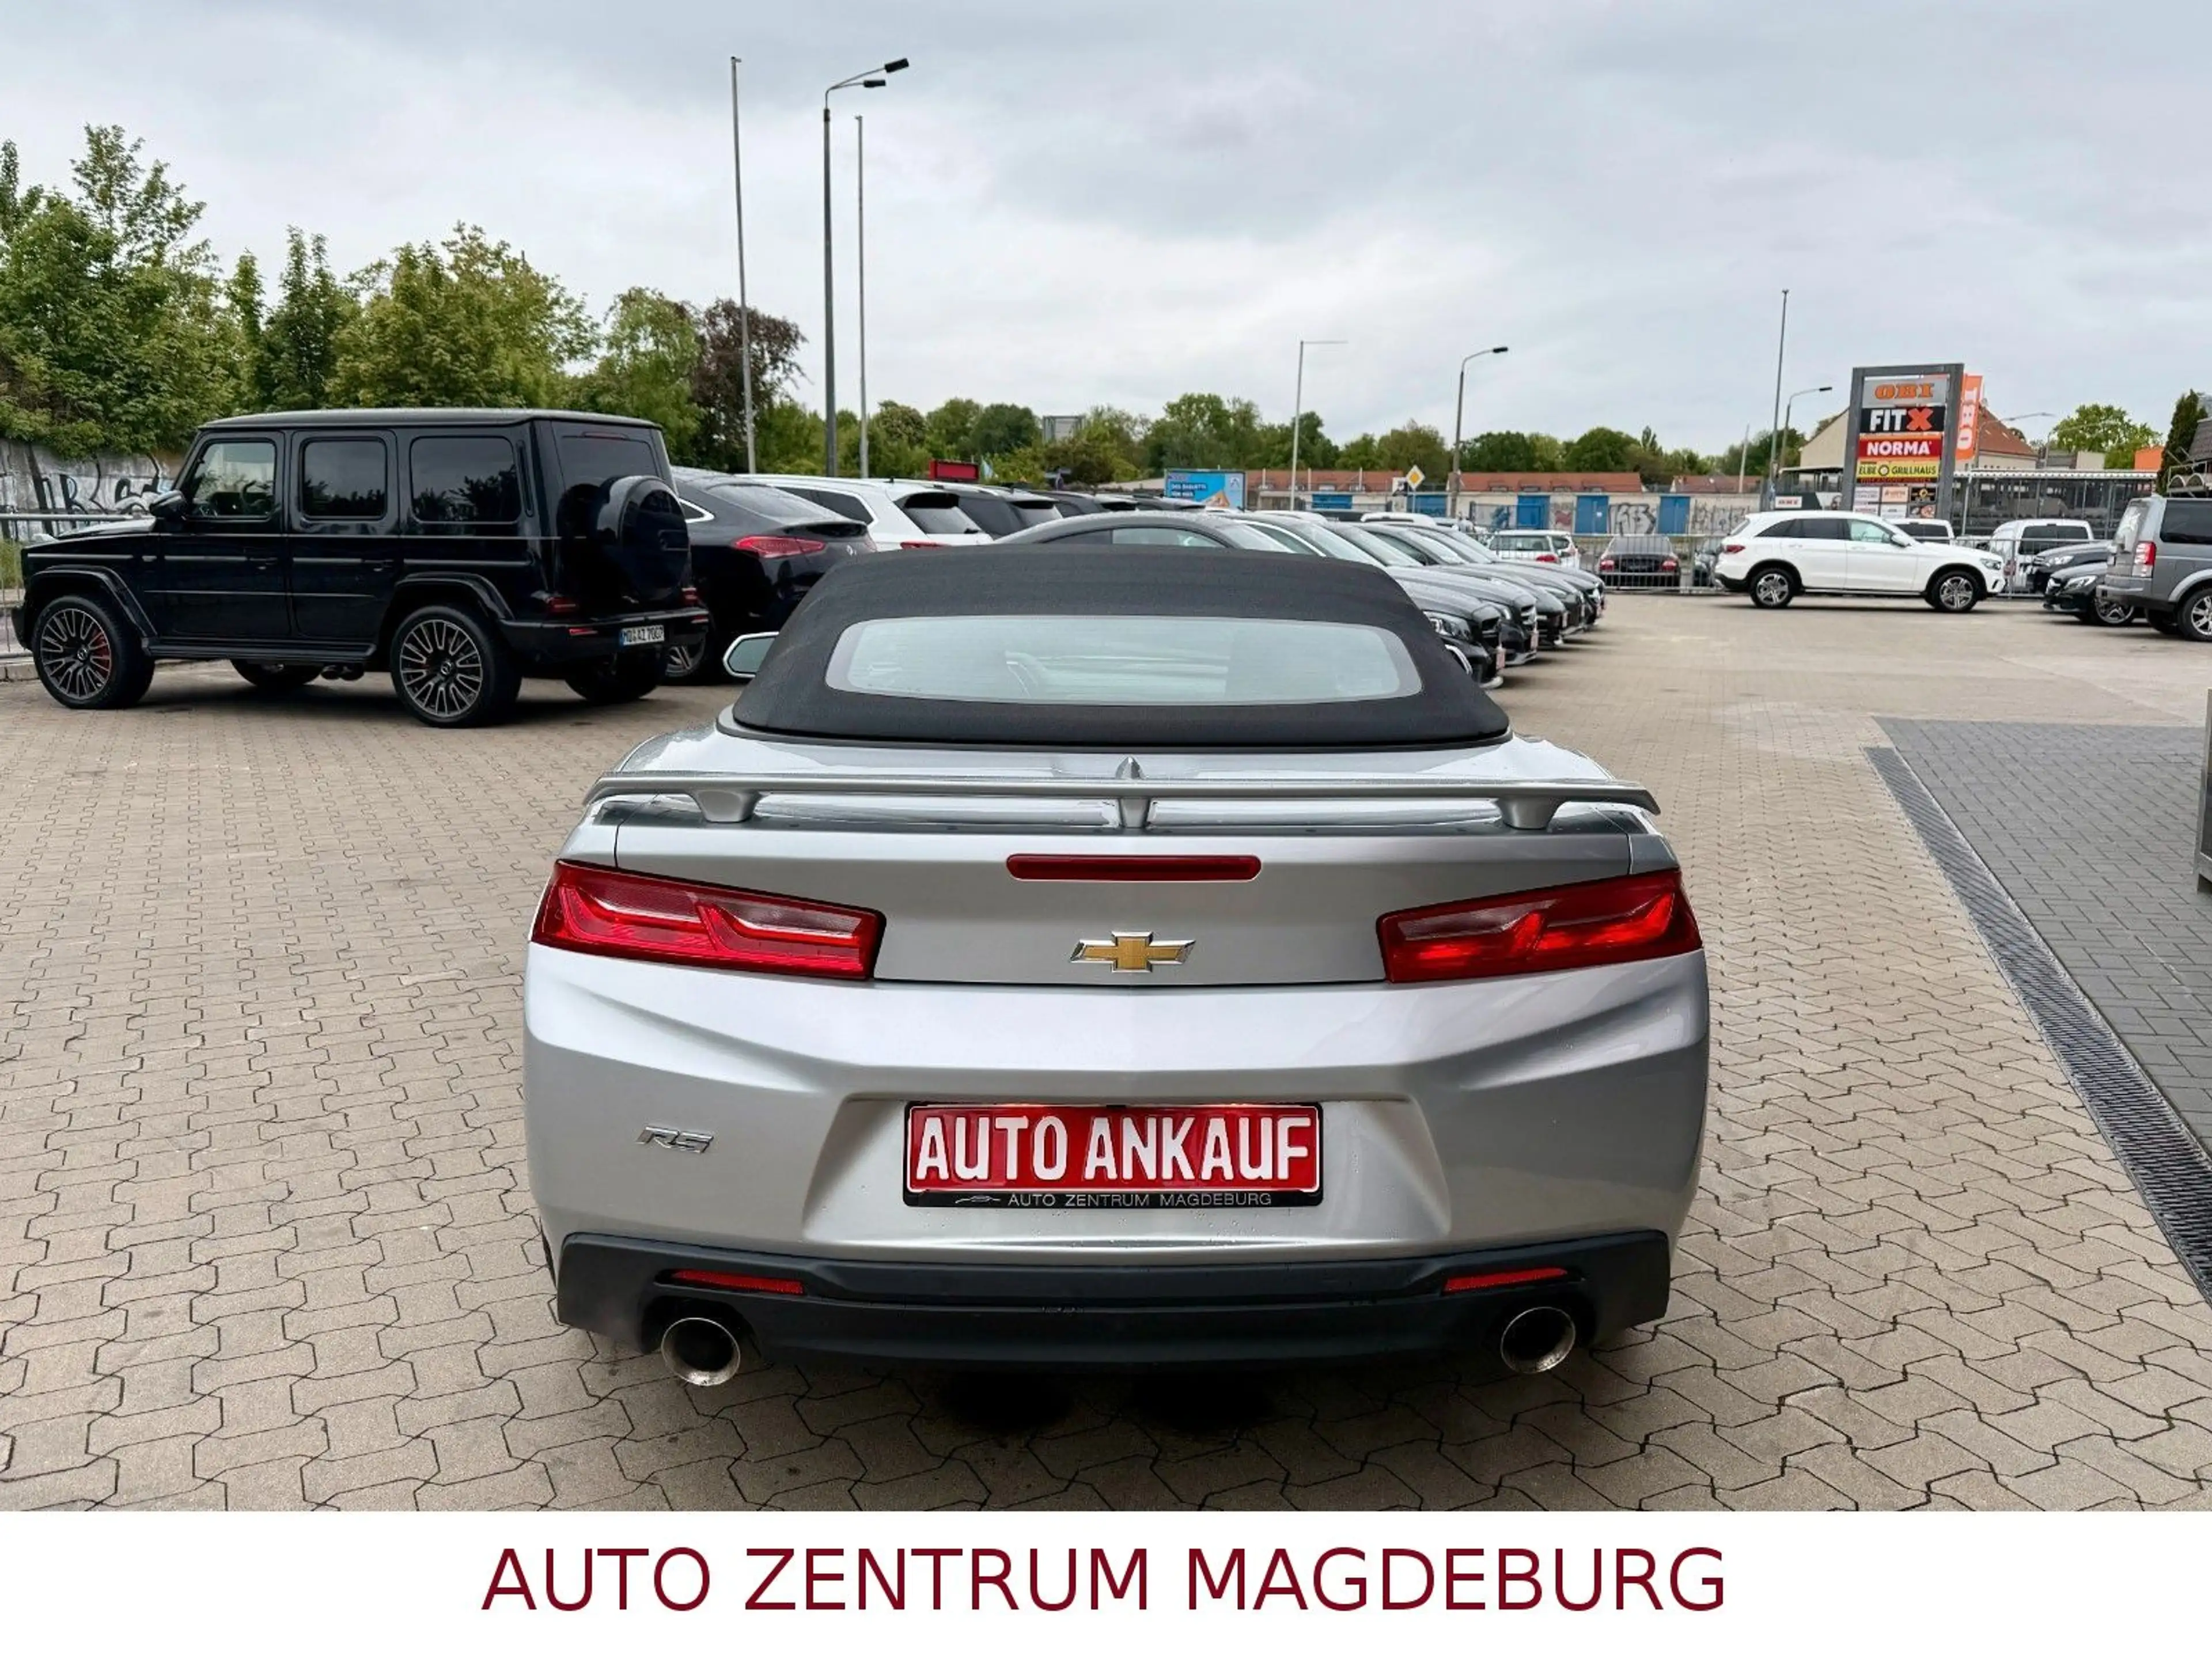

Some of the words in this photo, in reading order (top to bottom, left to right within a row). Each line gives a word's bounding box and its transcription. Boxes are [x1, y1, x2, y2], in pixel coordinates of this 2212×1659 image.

[1874, 382, 1934, 400] OBI
[1866, 441, 1930, 456] NORMA
[635, 1126, 714, 1154] RS
[915, 1116, 1067, 1181] AUTO
[1085, 1116, 1312, 1181] ANKAUF
[1008, 1194, 1055, 1206] AUTO
[1065, 1194, 1150, 1206] ZENTRUM
[1159, 1194, 1272, 1206] MAGDEBURG
